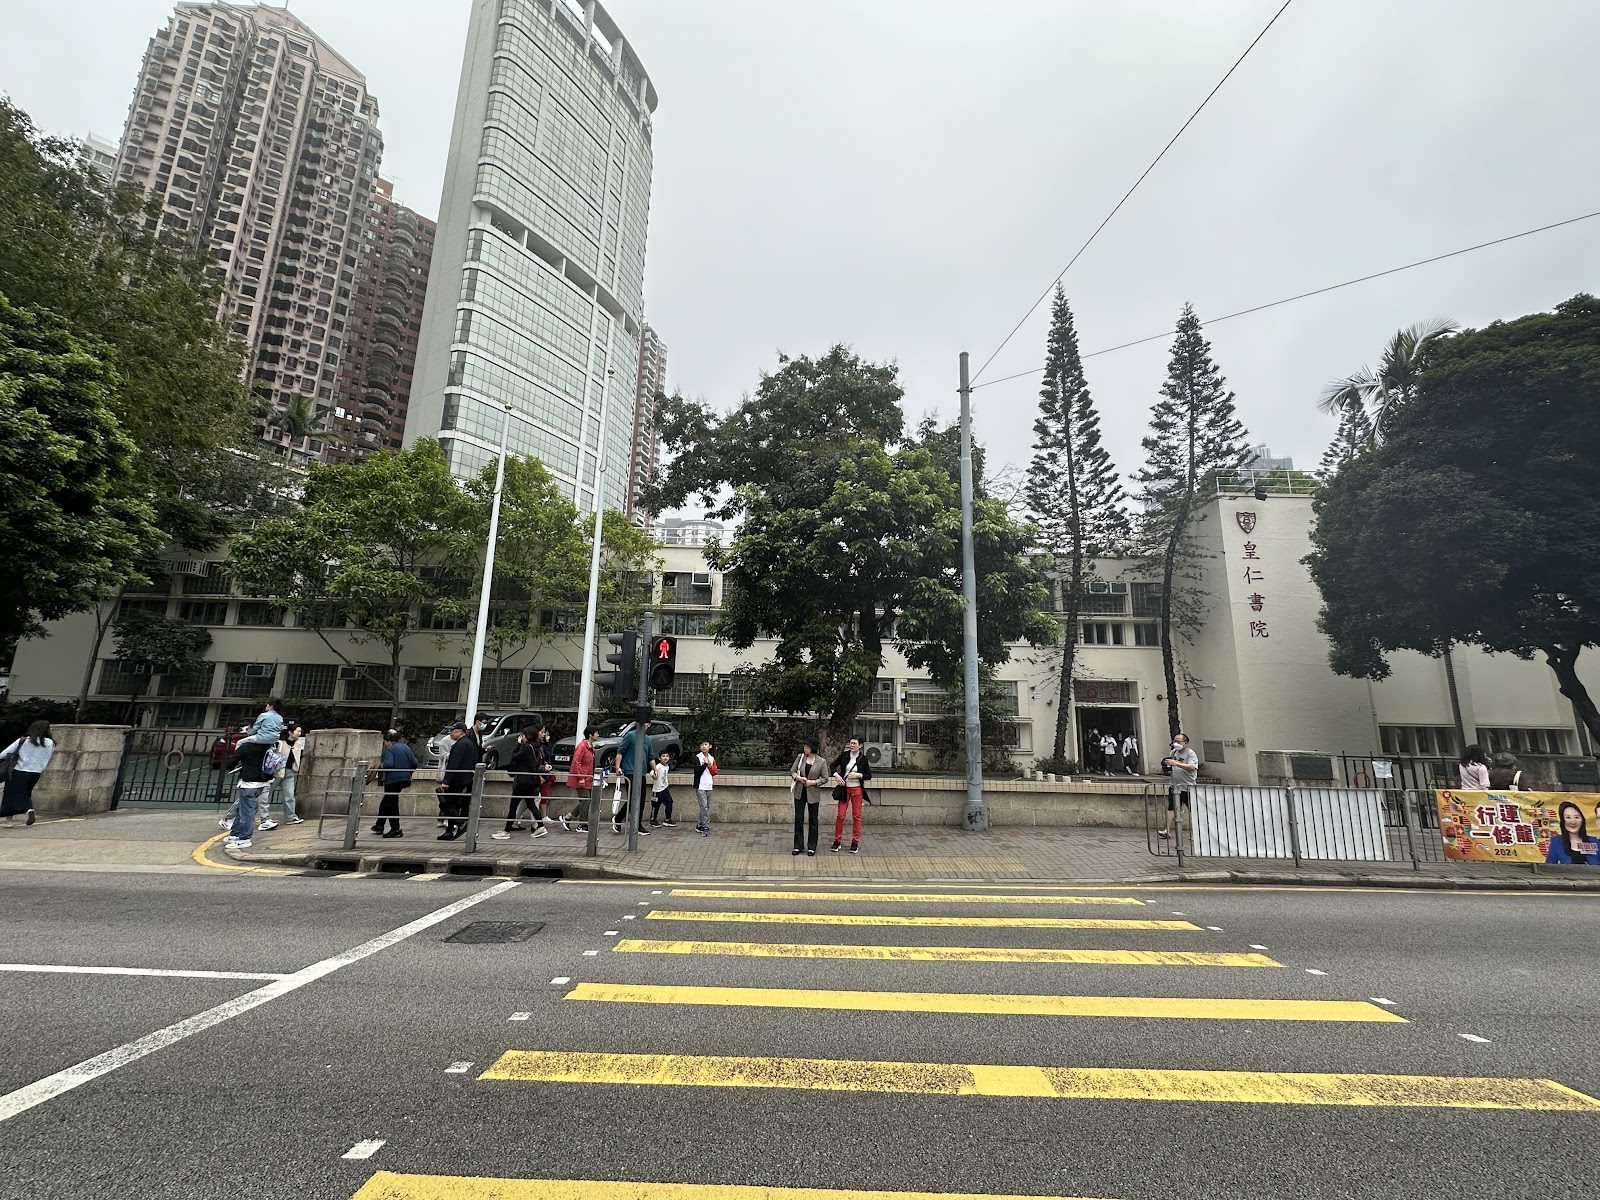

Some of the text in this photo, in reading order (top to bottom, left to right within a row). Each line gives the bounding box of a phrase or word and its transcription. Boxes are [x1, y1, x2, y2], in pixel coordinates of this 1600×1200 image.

[1242, 541, 1269, 638] 皇仁書院
[1476, 804, 1520, 825] 行運
[1472, 825, 1535, 844] 一條龍
[1494, 848, 1518, 857] 2024
